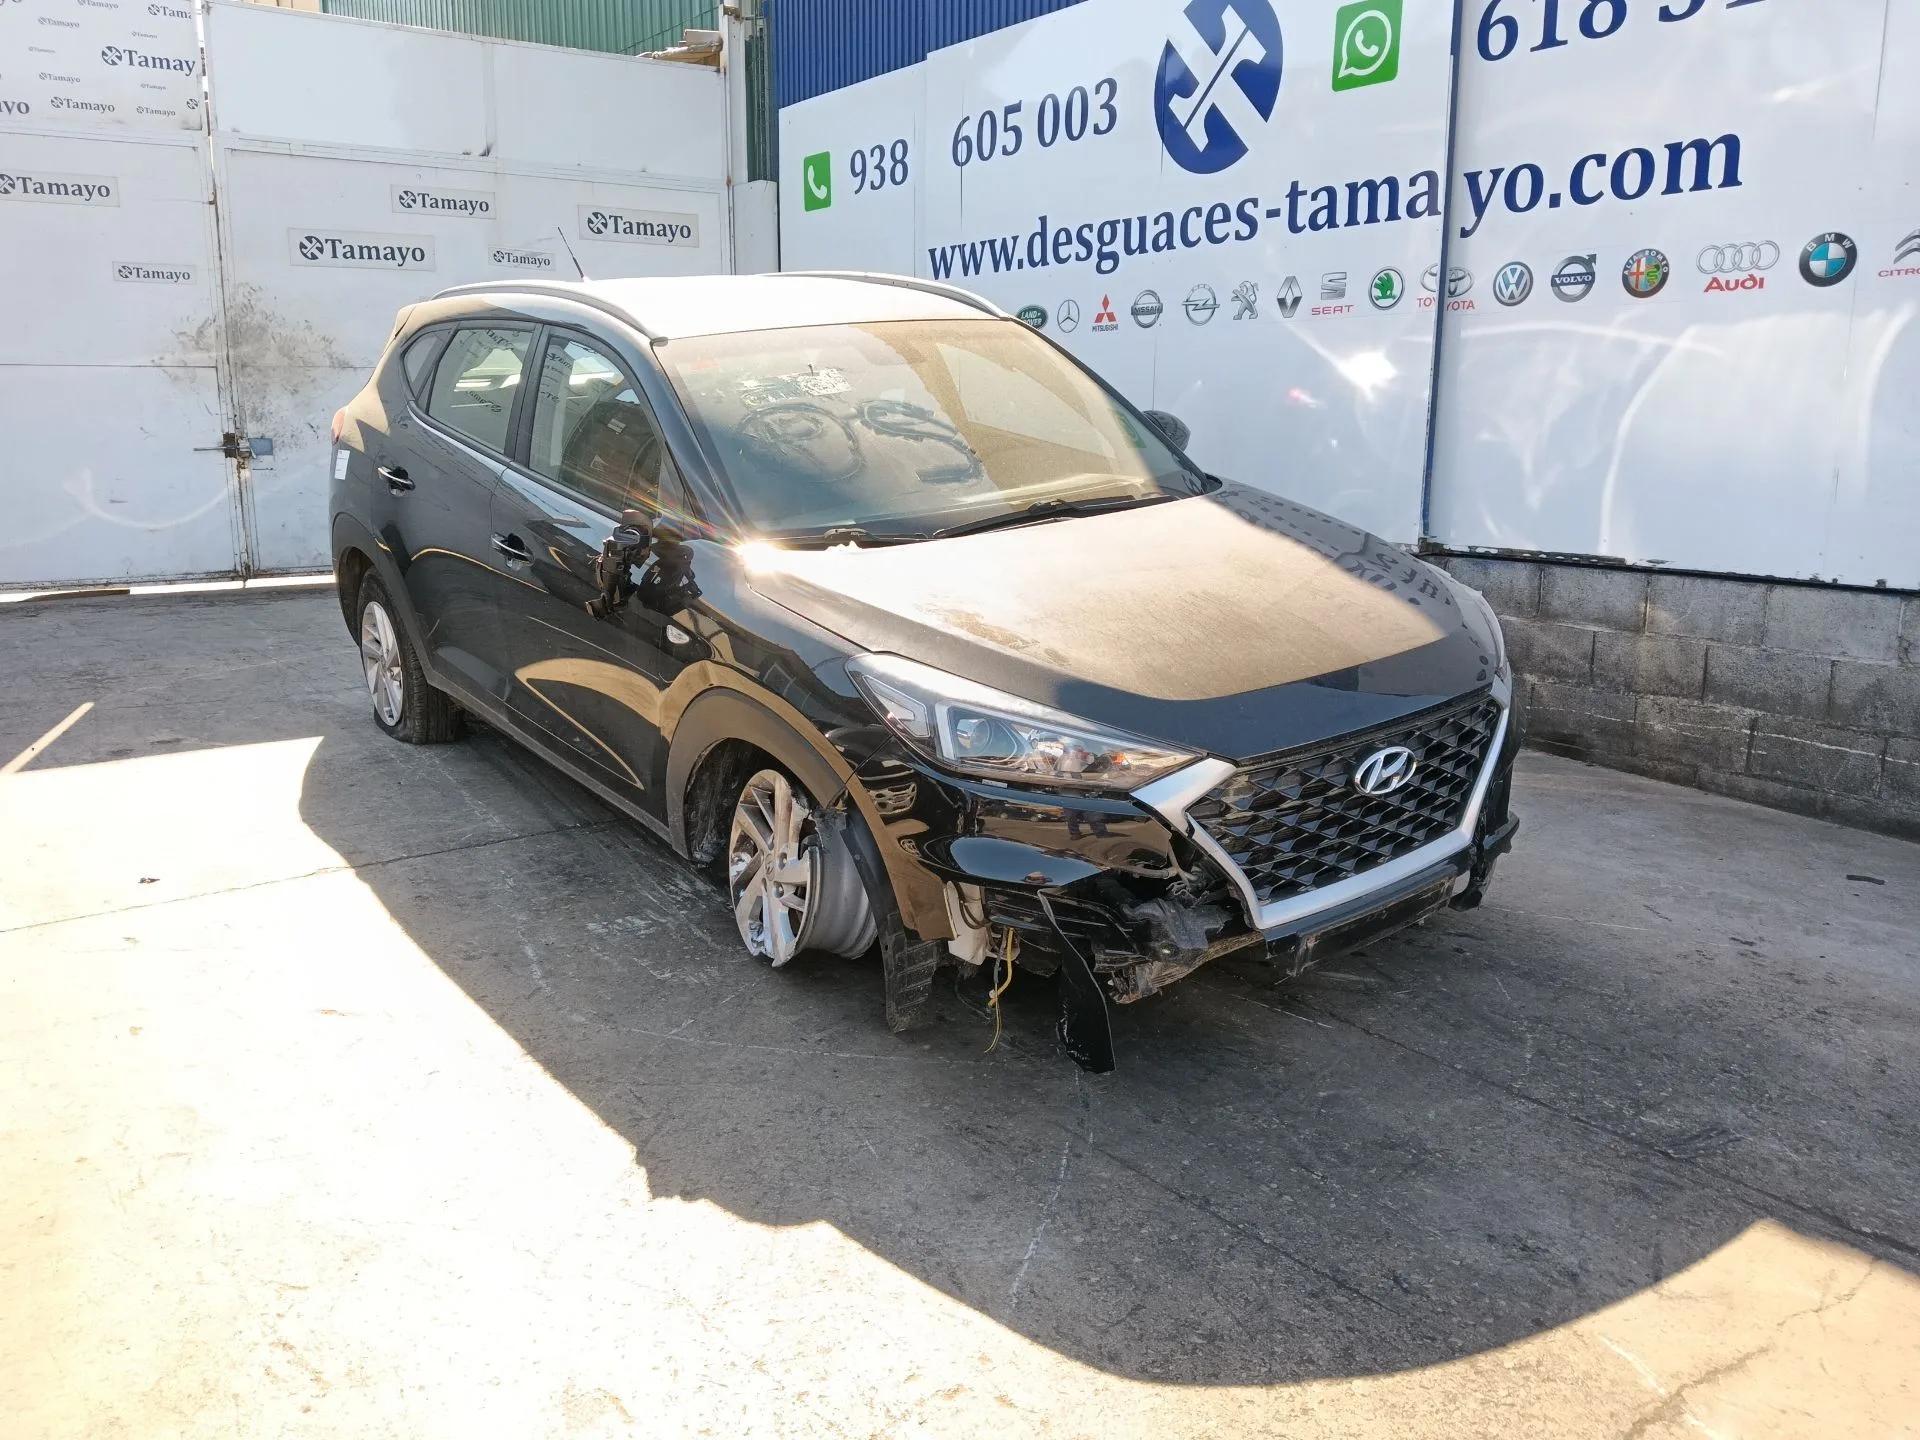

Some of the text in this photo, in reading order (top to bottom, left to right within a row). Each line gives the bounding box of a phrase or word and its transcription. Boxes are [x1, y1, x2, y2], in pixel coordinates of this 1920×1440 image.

[63, 98, 115, 114] Tamayo
[849, 77, 1118, 195] 938 605 003
[16, 176, 110, 201] Tamayo
[417, 192, 490, 215] Tamayo
[608, 215, 692, 242] Tamayo
[1806, 233, 1853, 252] BMW
[325, 238, 426, 267] Tamayo
[504, 251, 551, 268] Tamayo
[132, 266, 191, 283] Tamayo
[1554, 274, 1592, 285] VOLVO
[1134, 305, 1161, 315] NISSAN
[1311, 304, 1354, 316] SEAT
[1091, 323, 1119, 333] MITSUBISHI
